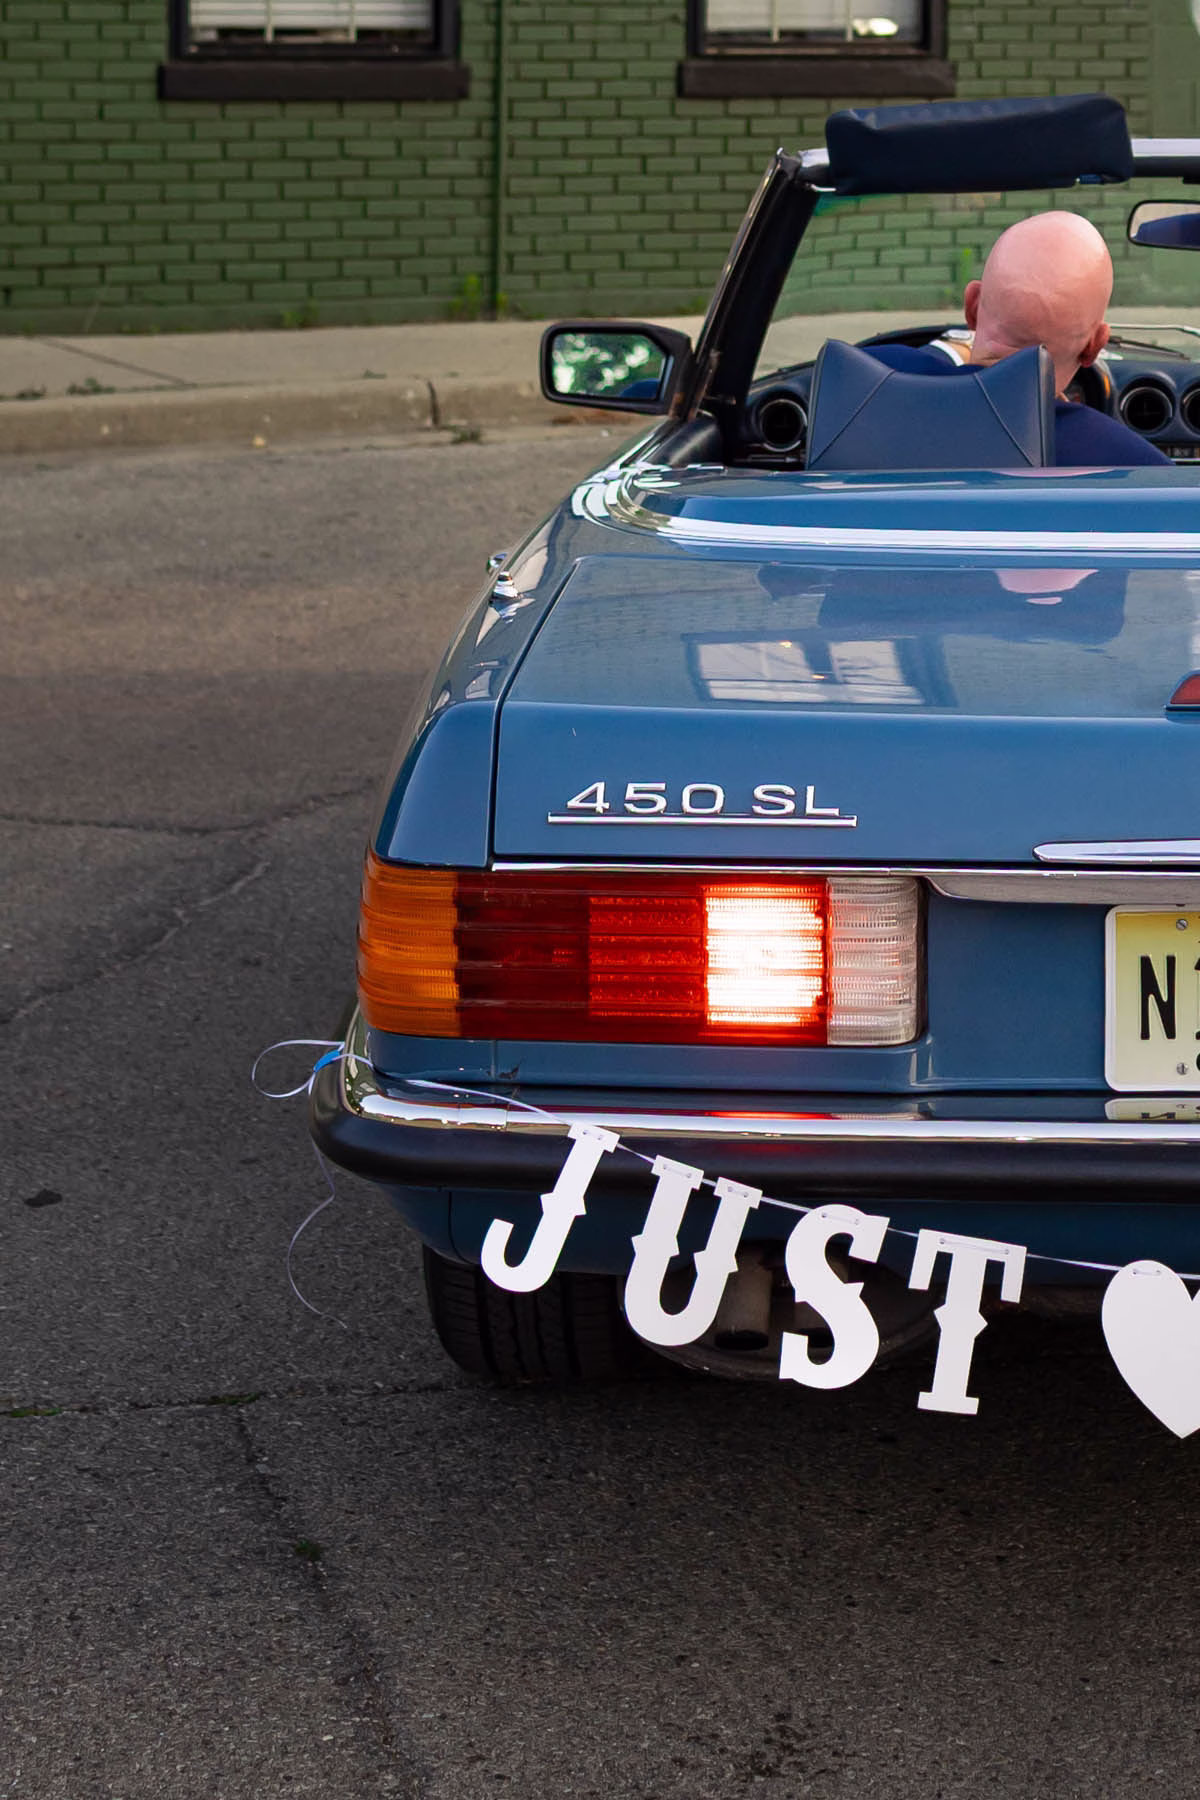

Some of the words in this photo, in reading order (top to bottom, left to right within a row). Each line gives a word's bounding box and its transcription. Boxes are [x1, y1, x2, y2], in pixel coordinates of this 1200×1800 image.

[566, 781, 726, 814] 450
[751, 784, 841, 817] SL
[480, 1121, 1028, 1416] JUST
